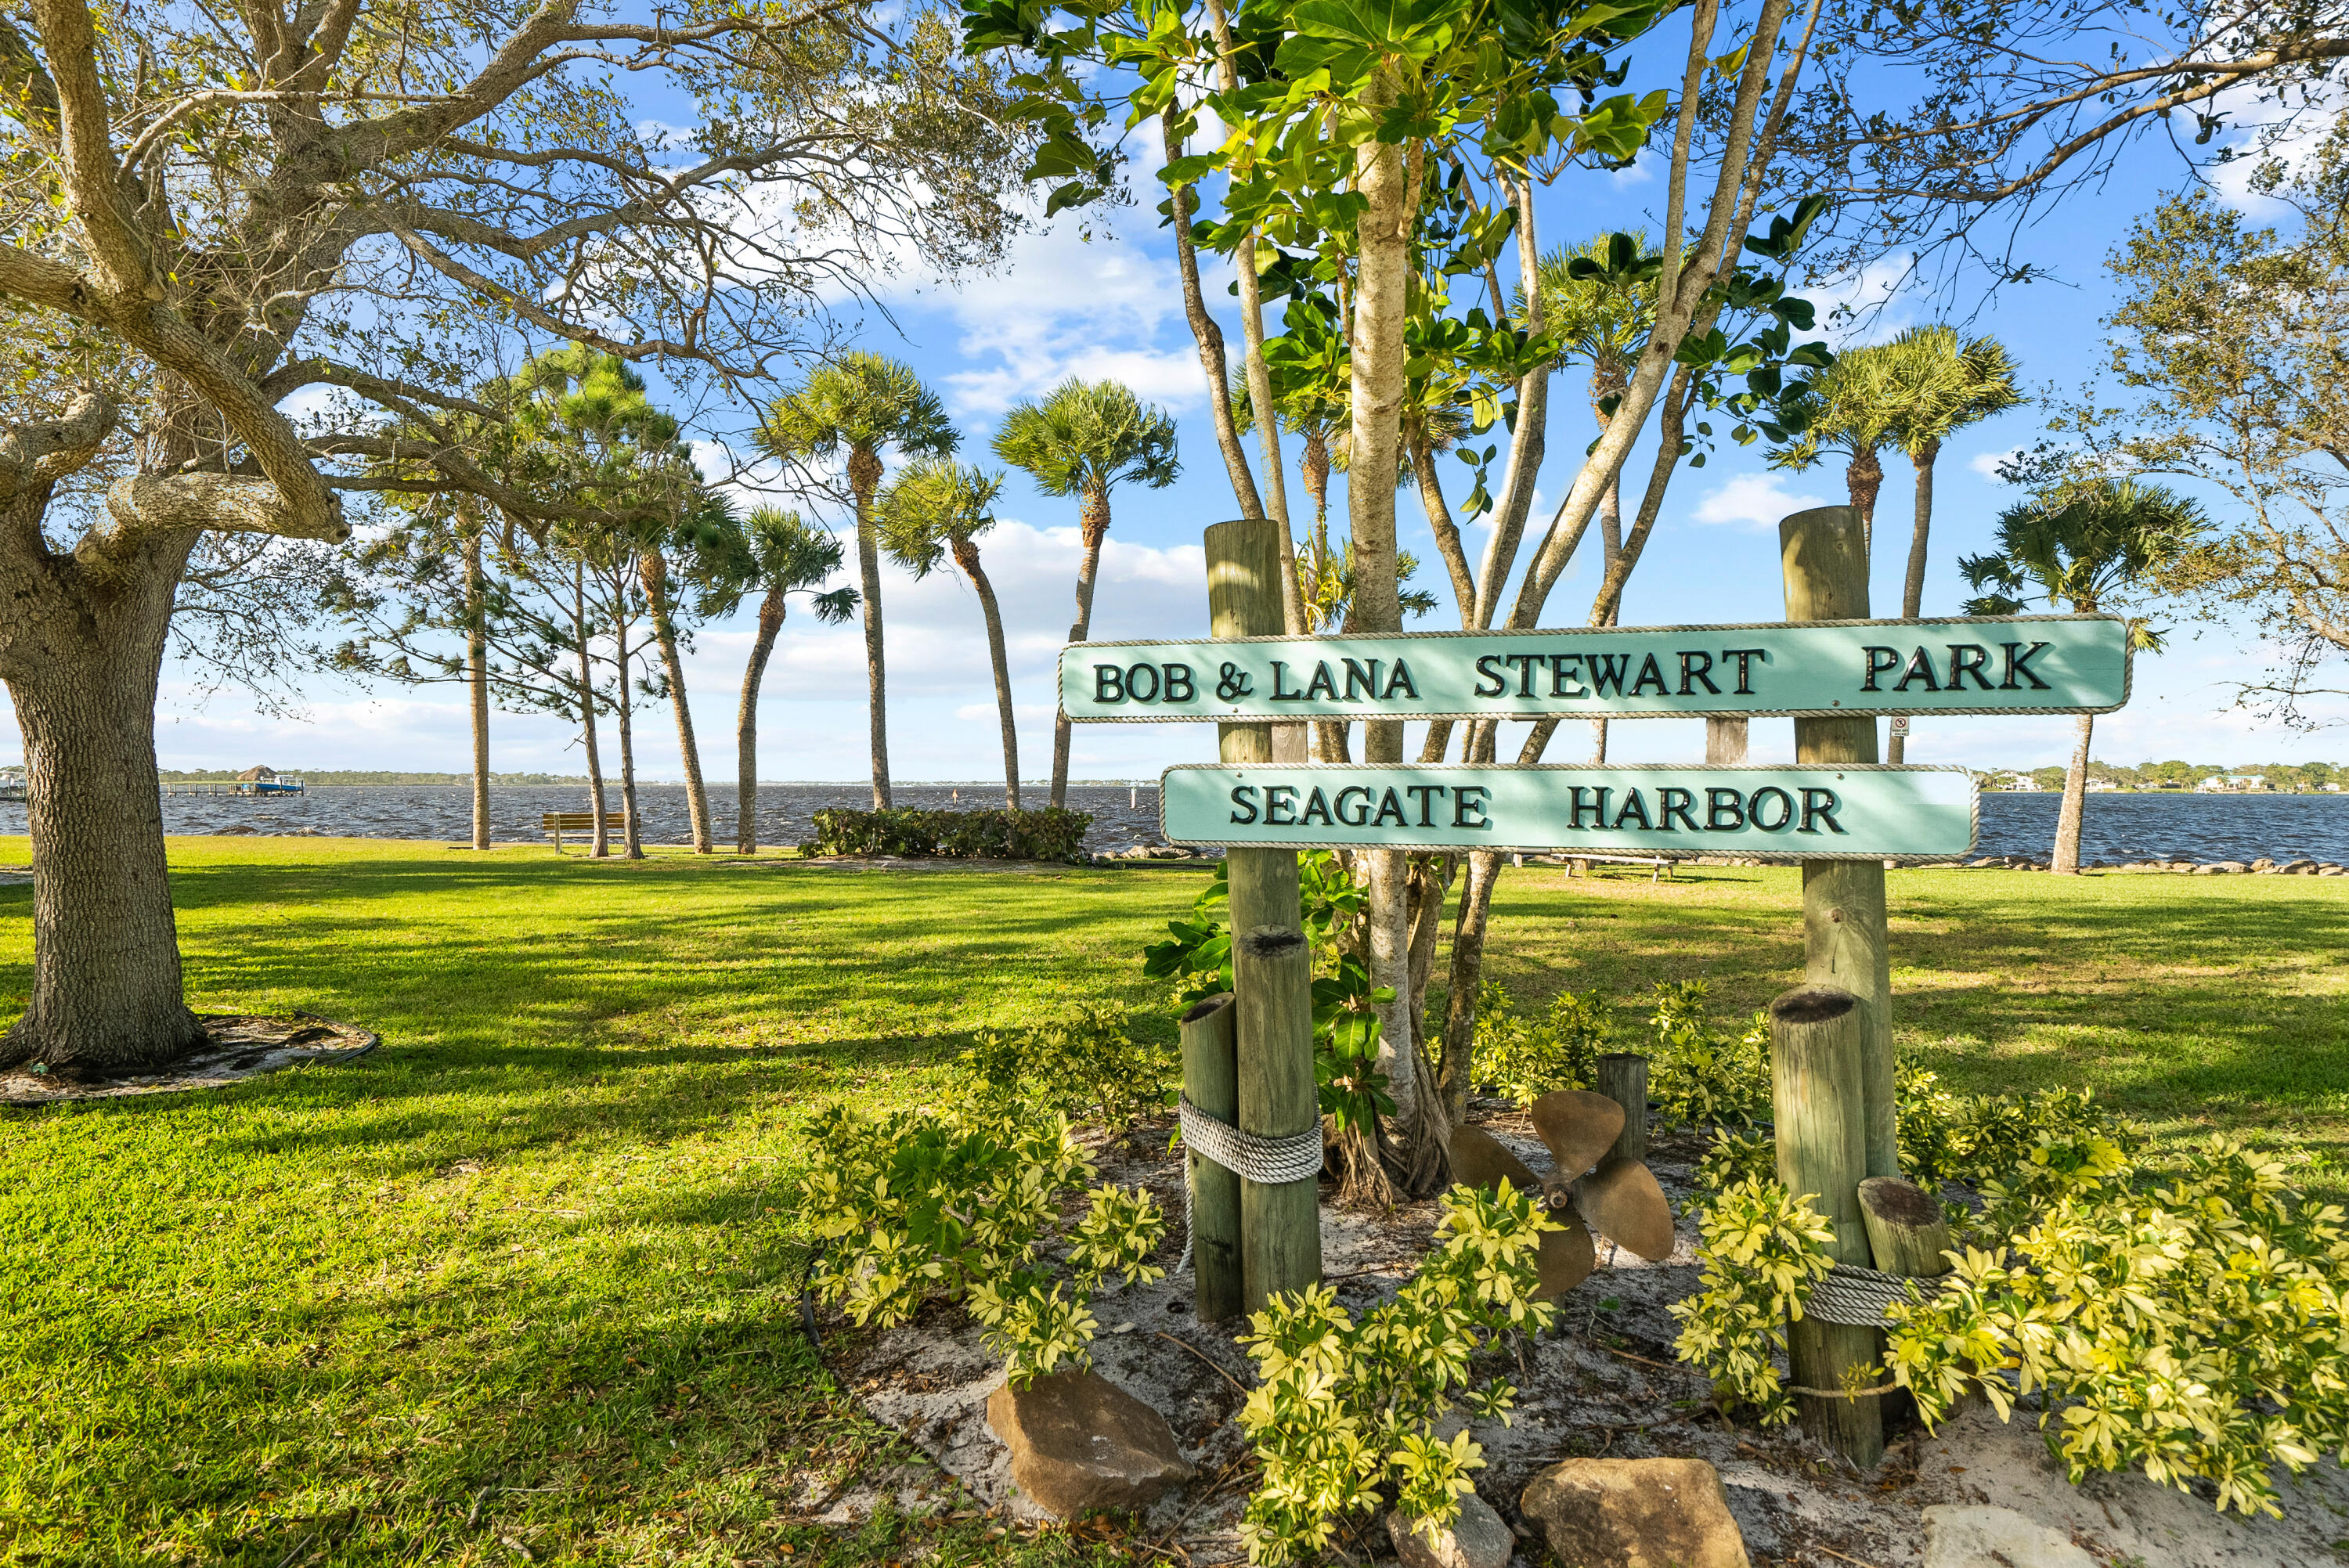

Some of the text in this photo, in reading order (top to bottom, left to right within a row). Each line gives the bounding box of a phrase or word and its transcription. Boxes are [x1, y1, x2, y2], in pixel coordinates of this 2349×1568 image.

[1093, 640, 2052, 703] BOB & LANA STEWART PARK
[1229, 784, 1846, 834] SEAGATE HARBOR
